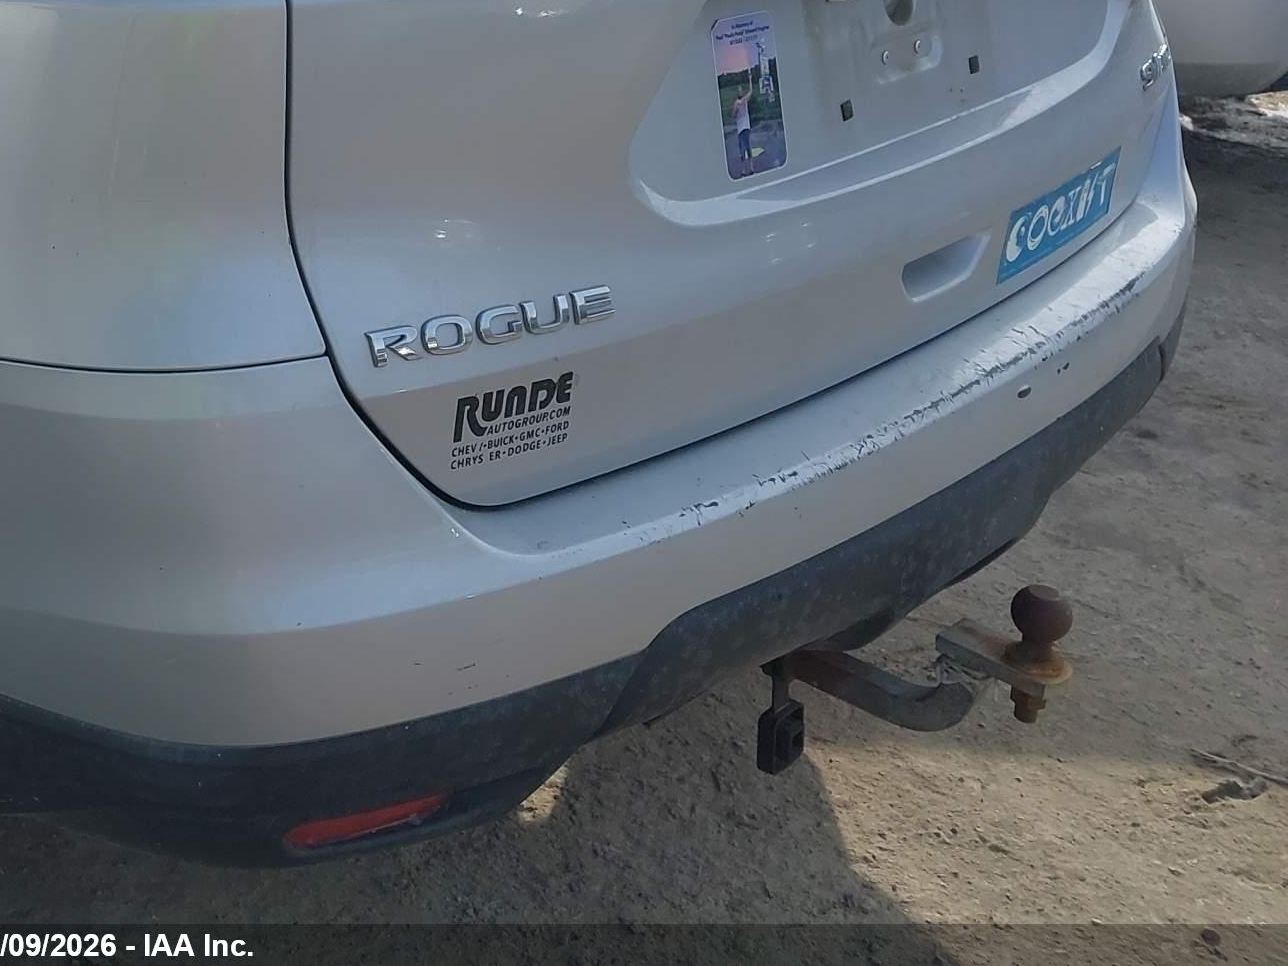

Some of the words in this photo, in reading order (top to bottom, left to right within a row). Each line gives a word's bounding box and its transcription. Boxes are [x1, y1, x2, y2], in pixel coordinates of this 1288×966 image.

[365, 285, 616, 367] ROGUE
[453, 371, 574, 443] RUNDE
[487, 405, 571, 436] AUTOGROUP.COM
